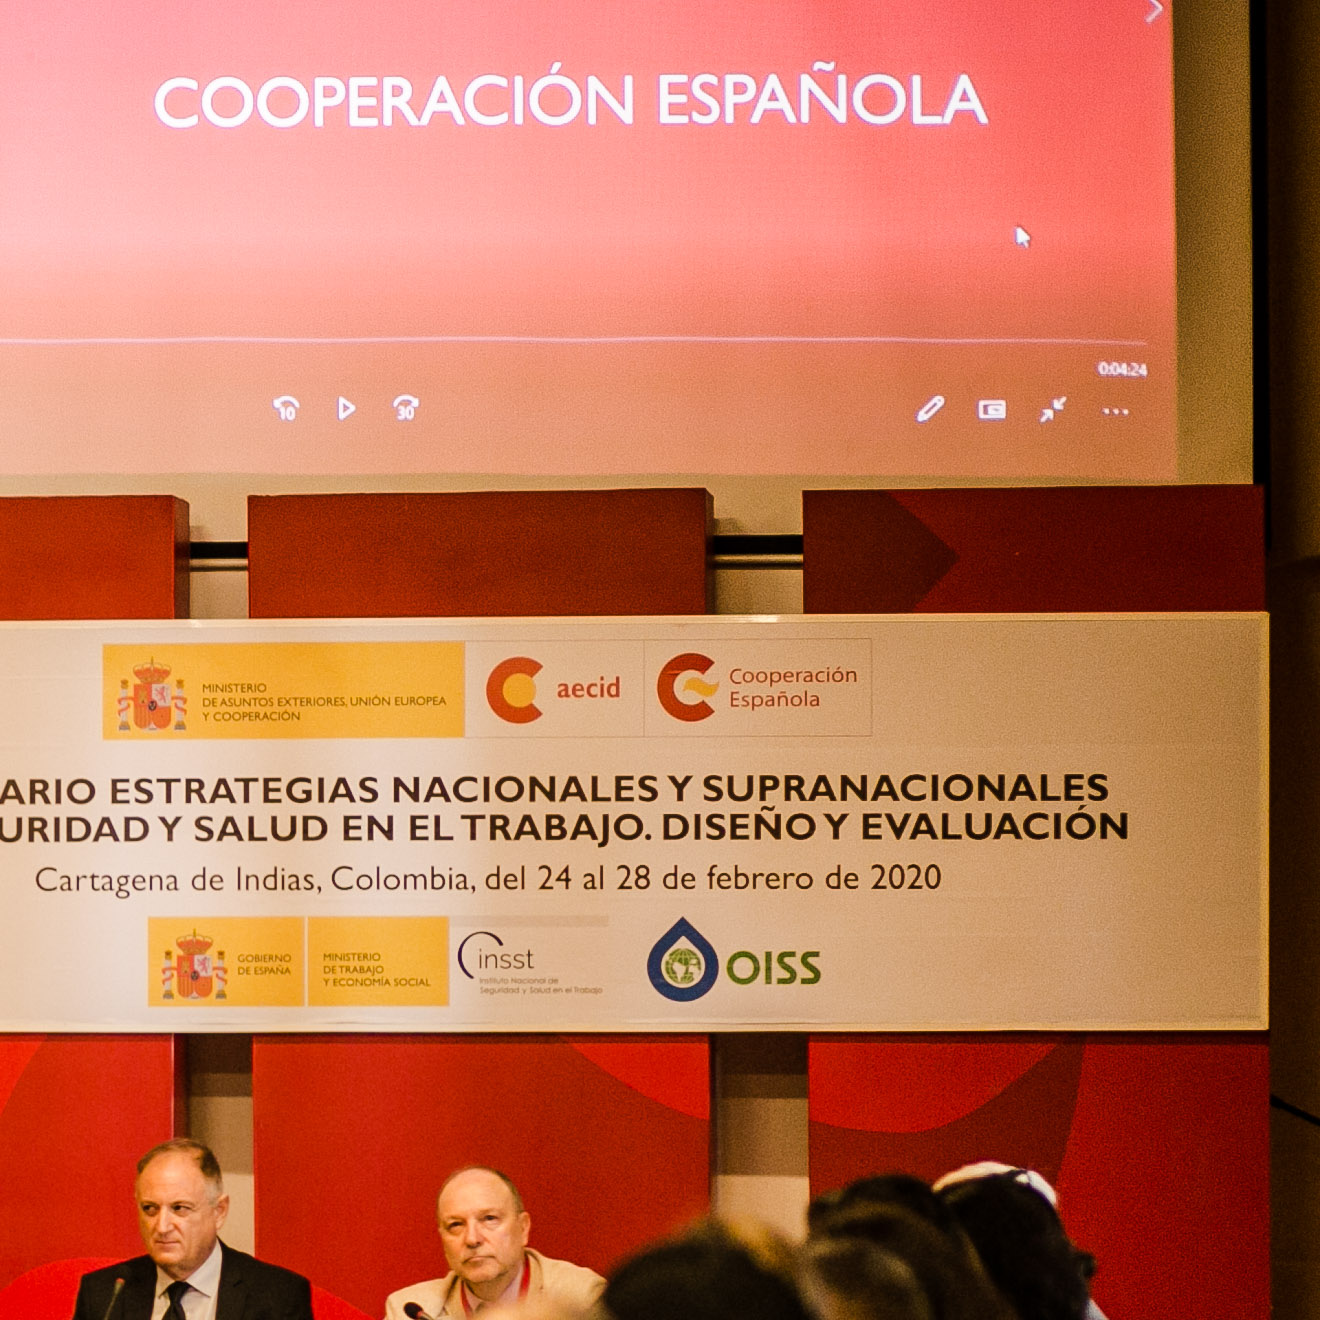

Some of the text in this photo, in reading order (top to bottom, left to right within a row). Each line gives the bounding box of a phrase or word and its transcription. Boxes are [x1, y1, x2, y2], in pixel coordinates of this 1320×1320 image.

[153, 62, 988, 130] COOPERACIÓN ESPAÑOLA
[1097, 361, 1148, 377] 0:04:24
[279, 406, 296, 421] 10
[397, 405, 415, 421] 30
[729, 666, 858, 687] Cooperación
[202, 683, 267, 693] MINISTERIO
[557, 675, 621, 699] aecid
[202, 694, 447, 708] DE ASUNTOS EXTERIORES, UNIÓN EUROPEA
[730, 689, 820, 711] Española
[202, 709, 301, 722] Y COOPERACIÓN
[112, 776, 378, 804] ESTRATEGIAS
[394, 775, 658, 803] NACIONALES
[668, 775, 694, 802] Y
[703, 773, 1109, 802] SUPRANACIONALES
[158, 816, 182, 842] Y
[195, 815, 328, 842] SALUD
[344, 815, 394, 841] EN
[410, 814, 454, 841] EL
[461, 813, 652, 847] TRABAJO.
[662, 806, 817, 841] DISEÑO
[823, 813, 850, 840] Y
[862, 805, 1129, 841] EVALUACIÓN
[35, 863, 942, 899] Cartagena de Indias, Colombia, del 24 al 28 de febrero de 2020
[237, 954, 291, 963] GOBIERNO
[323, 953, 381, 962] MINISTERIO
[478, 948, 535, 969] insst
[237, 964, 291, 975] DE ESPAÑA
[323, 965, 384, 976] DE TRABAJO
[726, 950, 822, 986] OISS
[323, 976, 431, 987] Y ECONOMÍA SOCIAL
